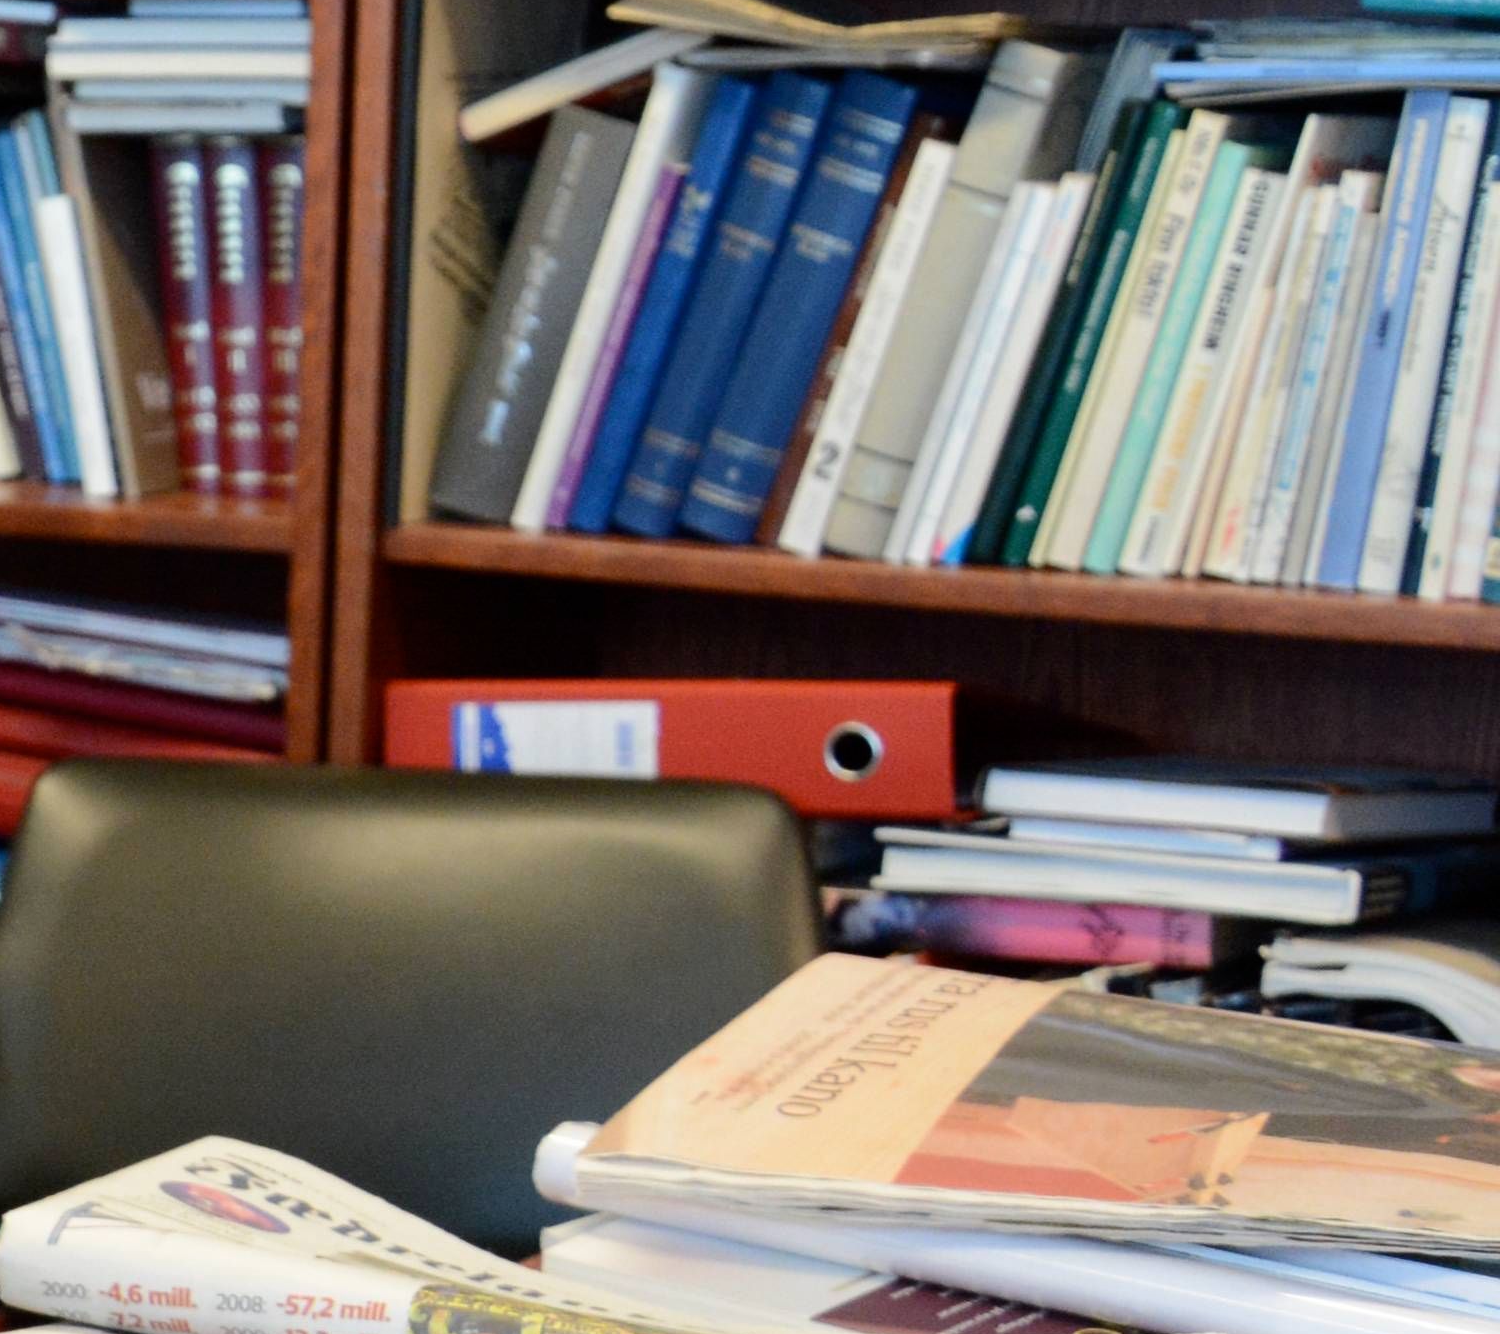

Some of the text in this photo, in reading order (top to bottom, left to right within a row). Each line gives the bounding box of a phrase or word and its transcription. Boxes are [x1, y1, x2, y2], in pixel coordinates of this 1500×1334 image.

[773, 1056, 884, 1124] kano
[41, 1279, 392, 1323] 2000: -4,6 mill. 2008: -57,2 mill.
